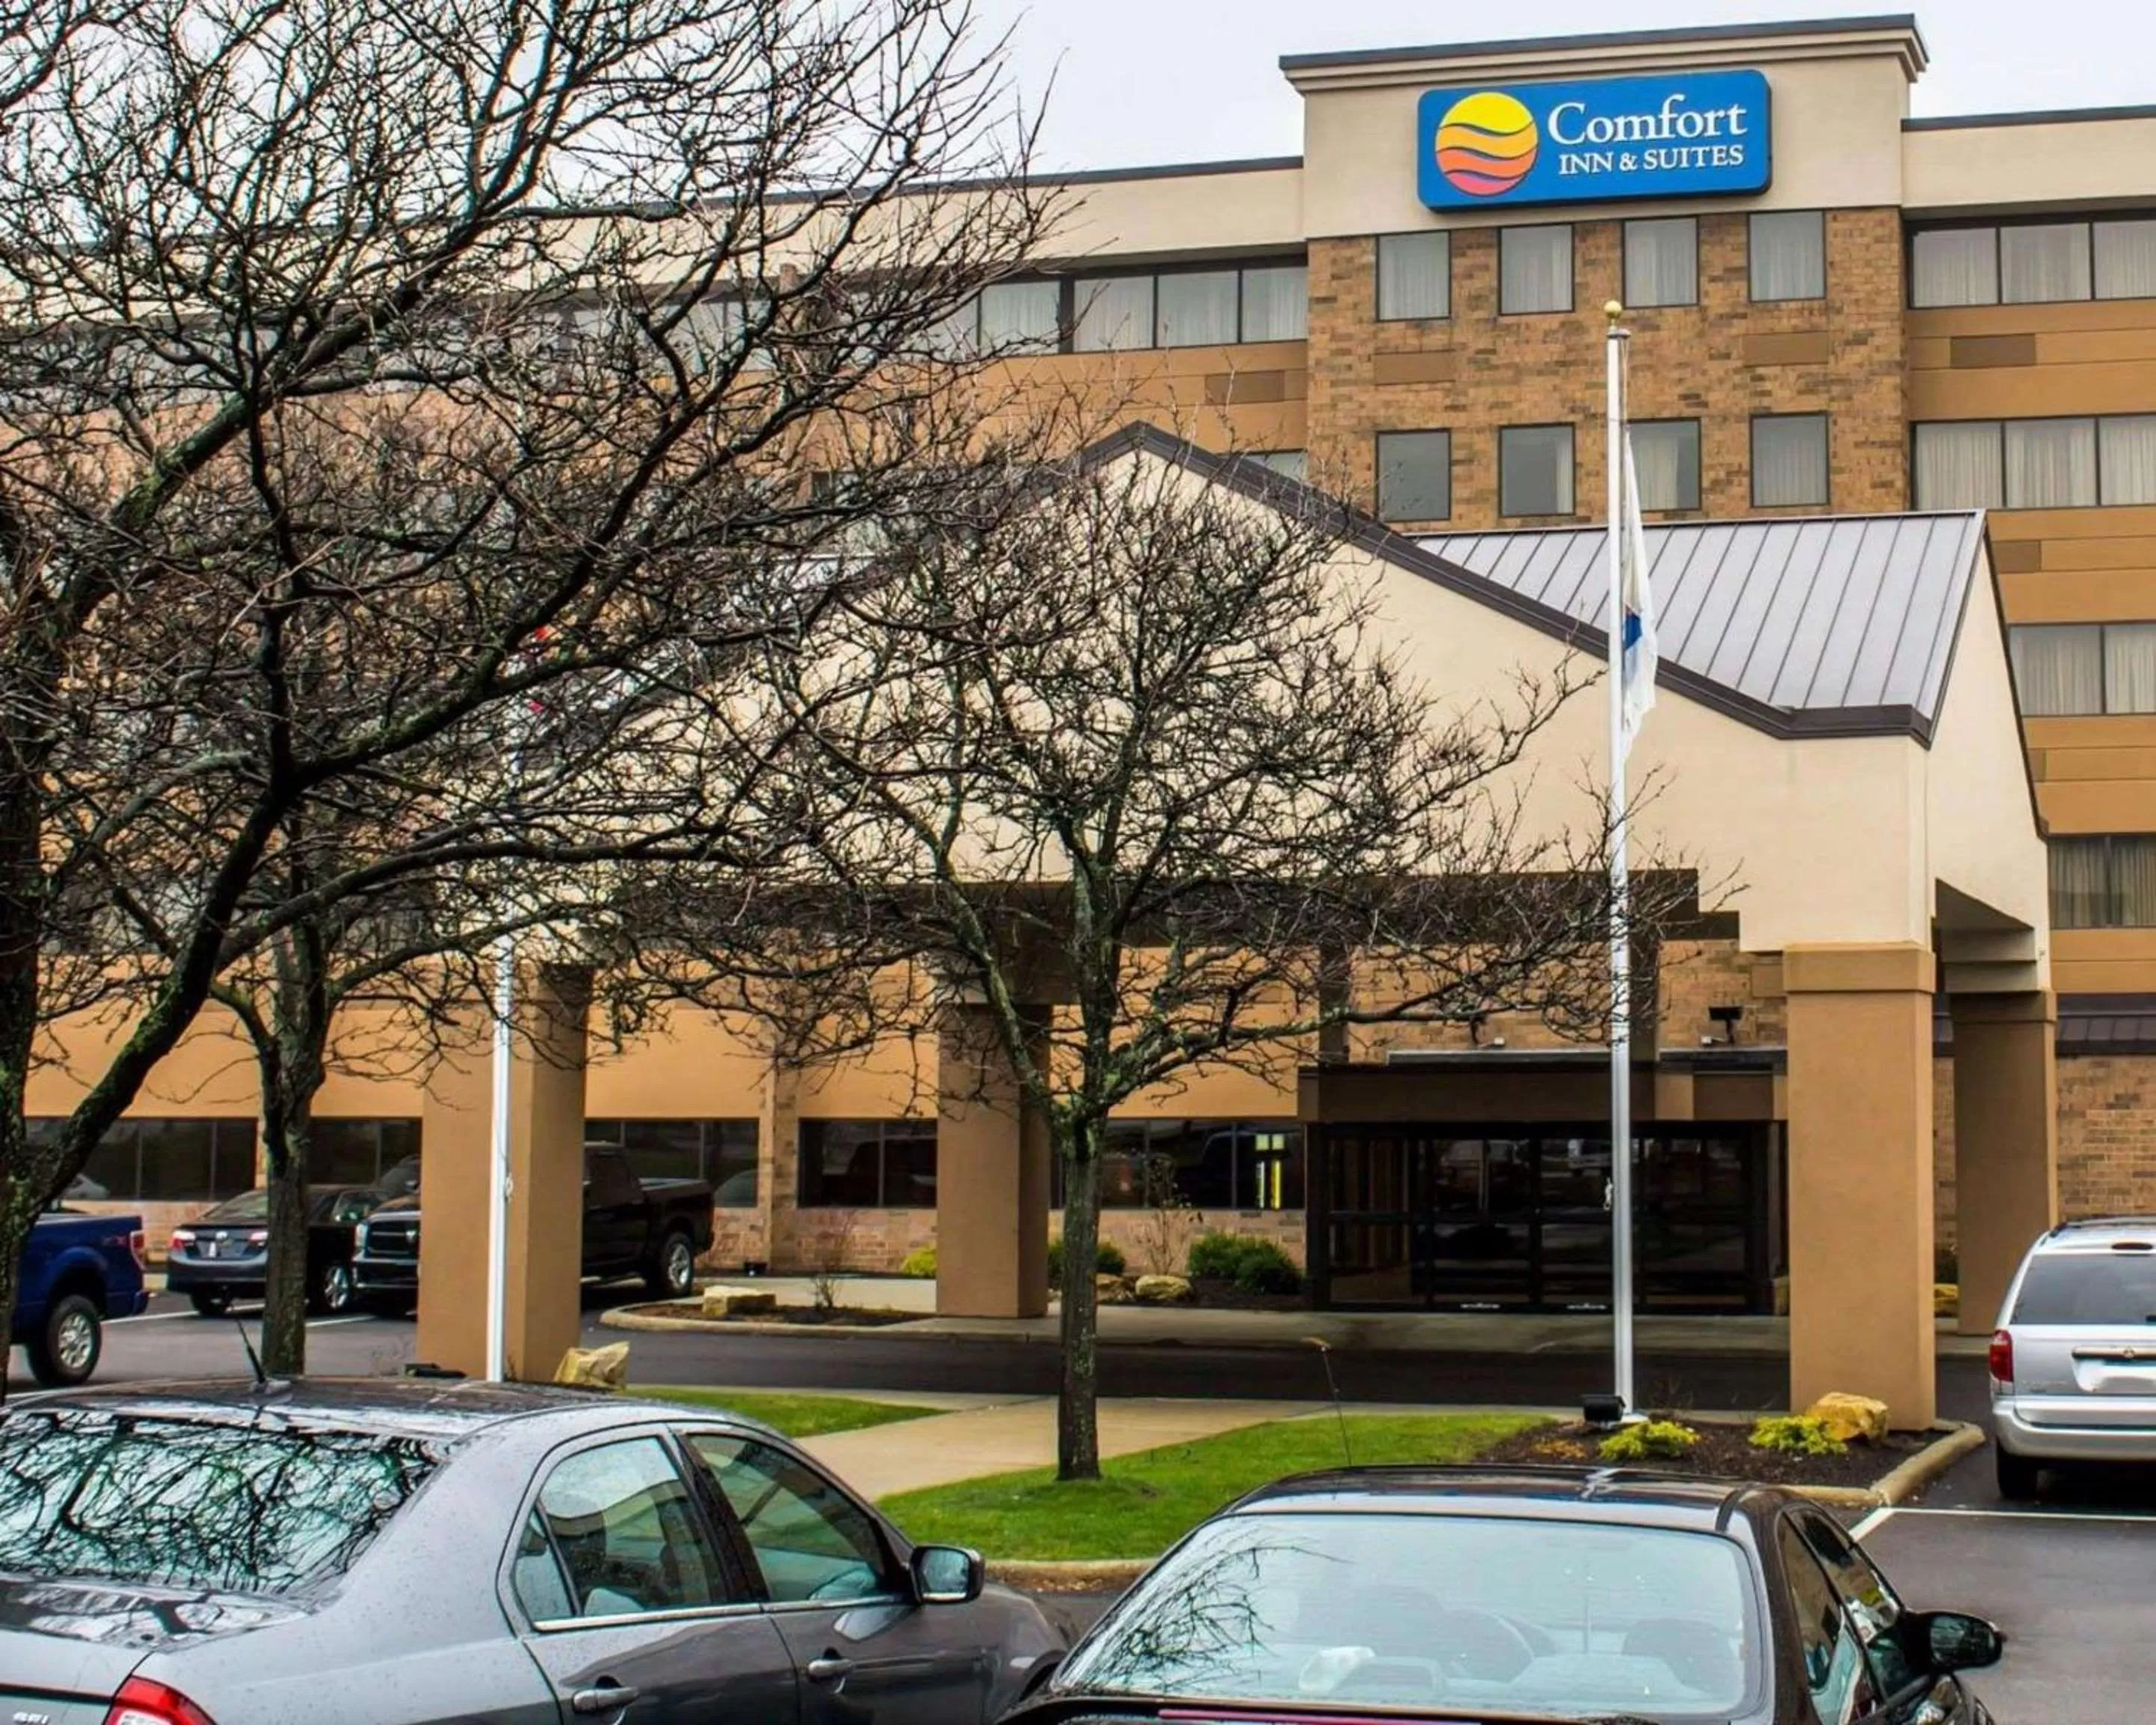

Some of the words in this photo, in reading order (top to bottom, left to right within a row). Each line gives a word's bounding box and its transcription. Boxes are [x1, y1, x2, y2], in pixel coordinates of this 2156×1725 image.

[1548, 94, 1747, 144] Comfort
[1559, 152, 1614, 174] INN
[1619, 152, 1638, 171] &
[1643, 144, 1744, 170] SUITES
